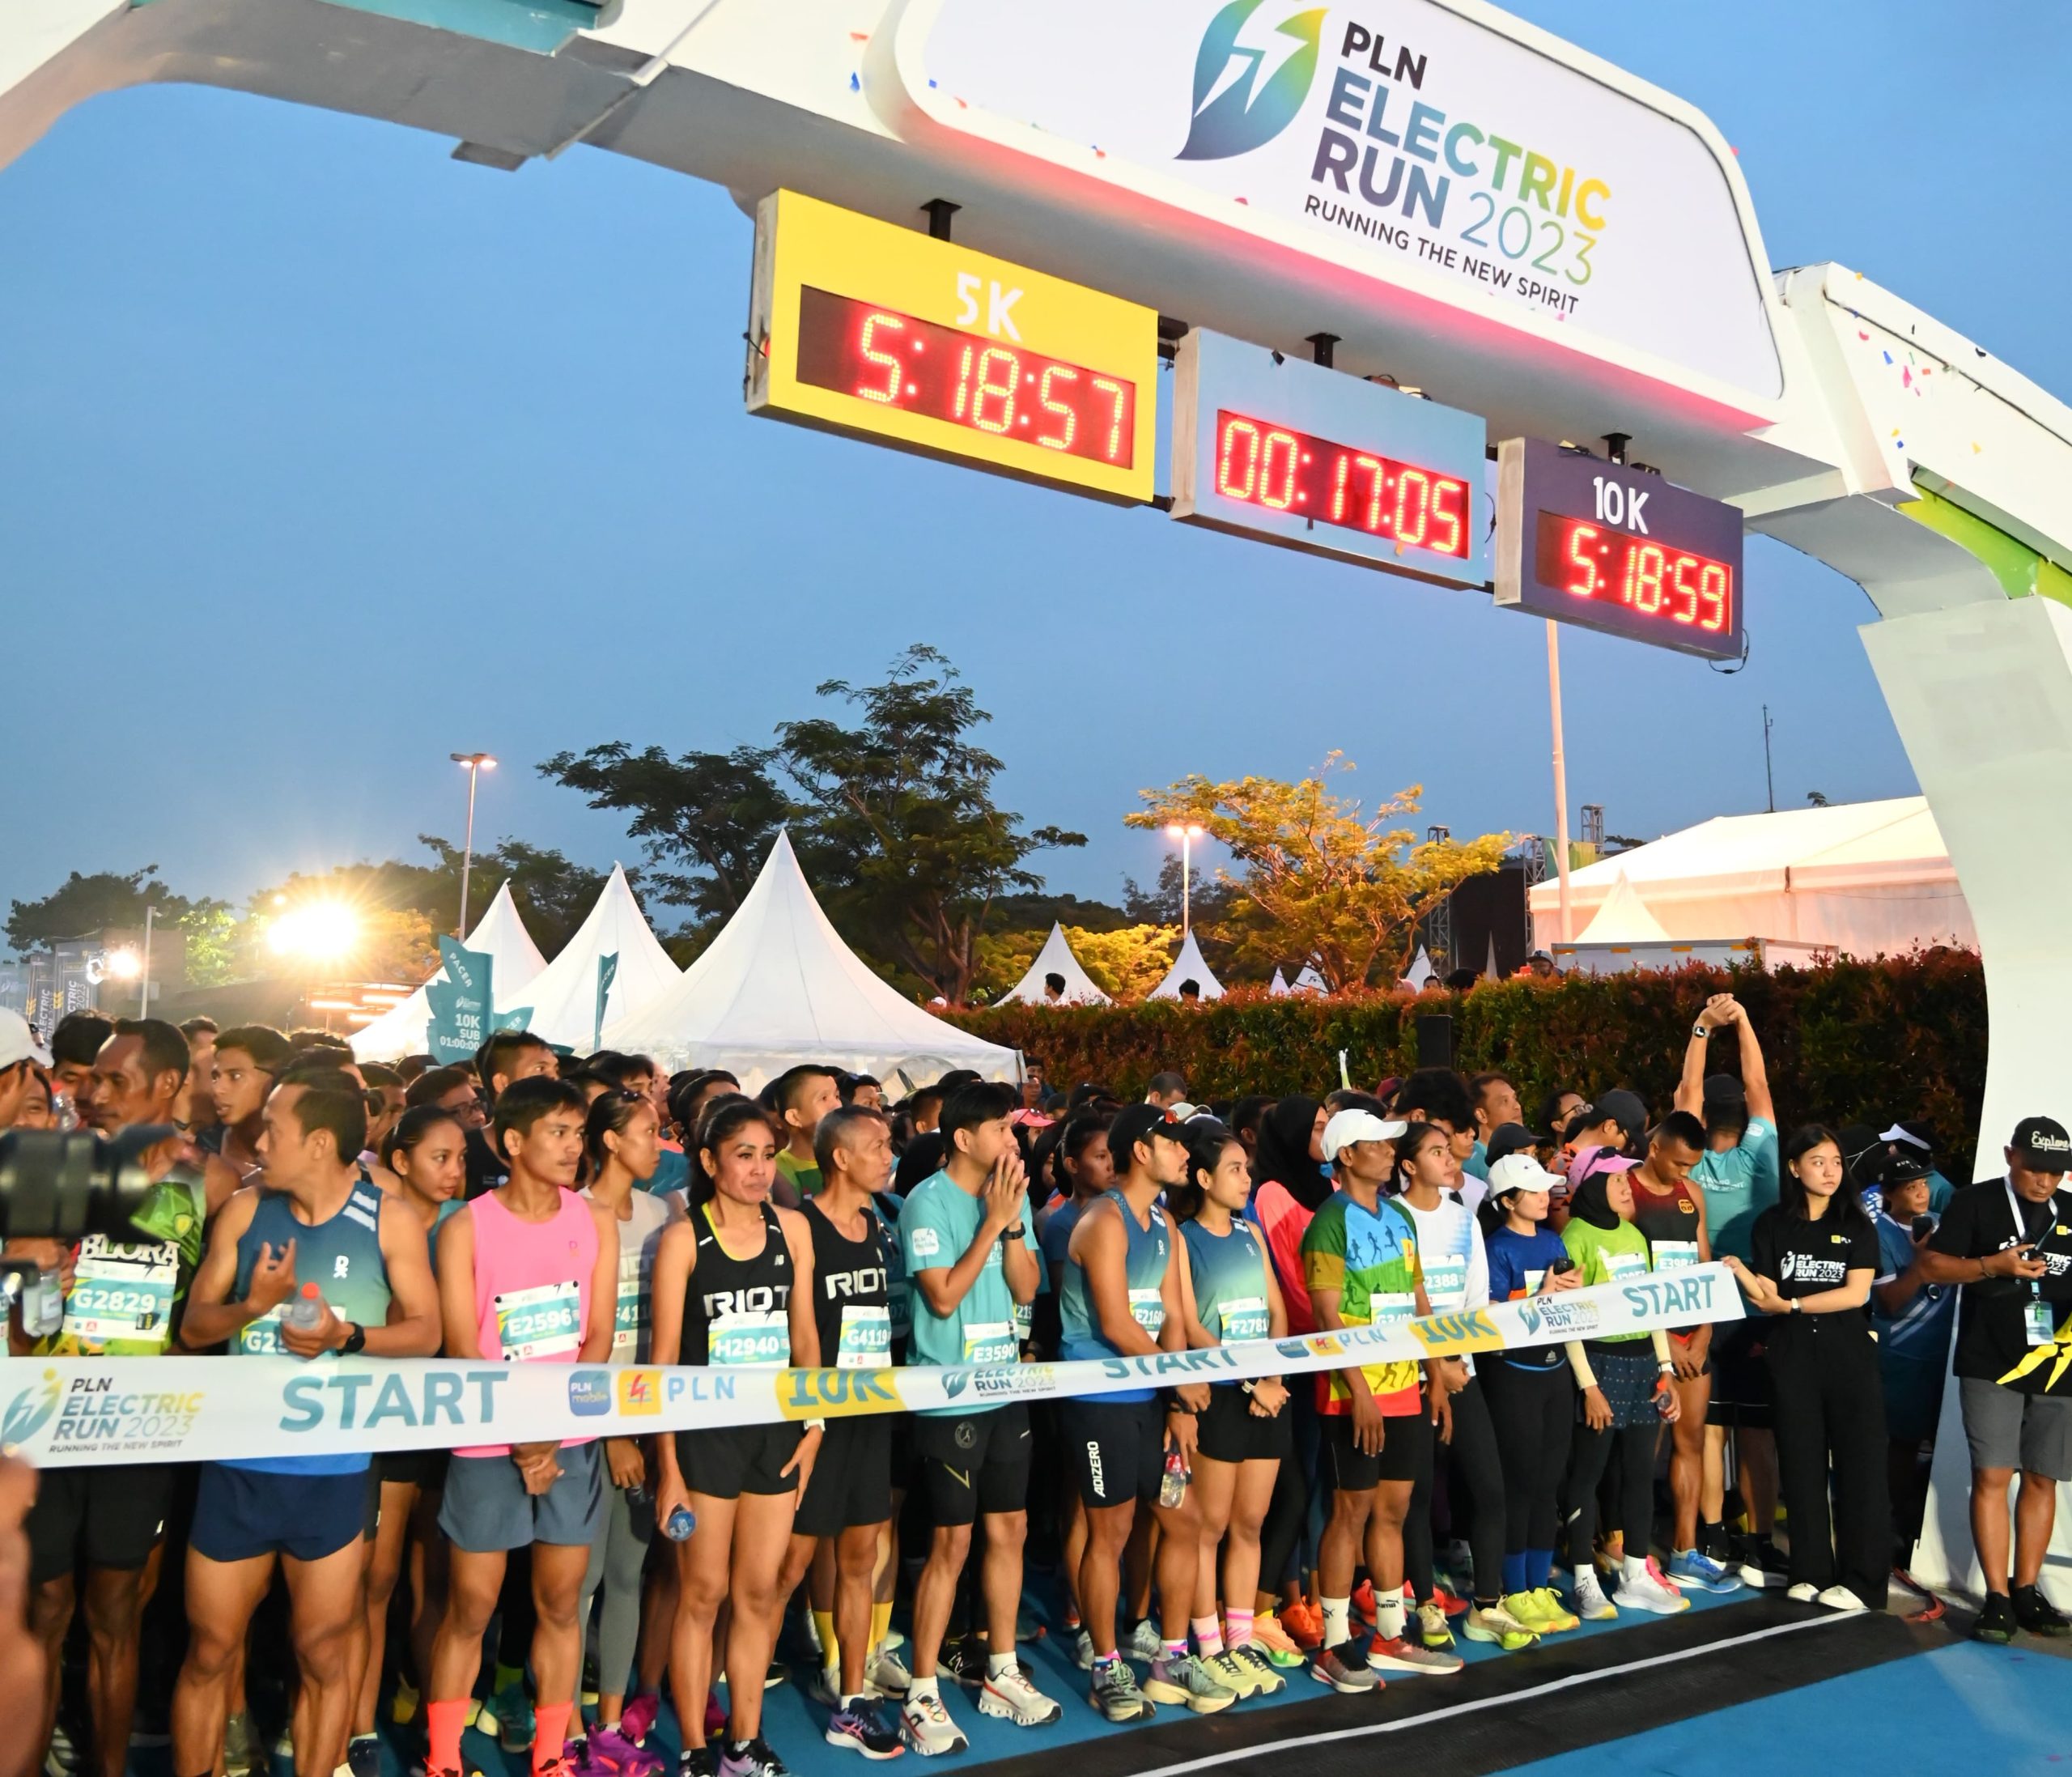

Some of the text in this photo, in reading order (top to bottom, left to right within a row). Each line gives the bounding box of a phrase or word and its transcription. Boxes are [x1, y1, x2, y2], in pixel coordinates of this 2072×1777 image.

[1341, 21, 1427, 91] PLN
[1326, 66, 1611, 231] ELECTRIC
[1311, 126, 1597, 285] RUN 2023
[1305, 194, 1578, 313] RUNNING THE NEW SPIRIT
[957, 272, 1023, 342] 5K
[1220, 420, 1459, 553] 00:17:05
[1593, 477, 1649, 534] 10K
[449, 952, 473, 988] PACER
[455, 1014, 481, 1029] 10K
[460, 1028, 480, 1040] SUB
[439, 1035, 480, 1051] 01:00:00
[1795, 1269, 1843, 1278] RUN 2023
[1796, 1260, 1845, 1270] ELECTRIC
[826, 1267, 887, 1299] RIOT
[1423, 1273, 1458, 1290] 2388
[74, 1288, 155, 1313] G2829
[703, 1286, 790, 1318] RIOT
[1537, 1296, 1552, 1305] PLN
[1539, 1300, 1597, 1316] ELECTRIC
[1622, 1274, 1715, 1318] START
[507, 1308, 571, 1337] E2596
[1136, 1308, 1162, 1324] E2160
[1230, 1317, 1268, 1334] F2781
[1415, 1309, 1497, 1344] 10K
[1546, 1314, 1571, 1327] RUN
[715, 1337, 779, 1358] H2940
[847, 1328, 888, 1344] G4119
[1338, 1328, 1387, 1347] PLN
[974, 1343, 1015, 1363] E3590
[1102, 1349, 1238, 1379] START
[71, 1377, 113, 1392] PLN
[571, 1382, 592, 1392] PLN
[668, 1375, 736, 1403] PLN
[788, 1371, 896, 1407] 10K
[974, 1376, 1055, 1391] RUN 2023
[62, 1392, 206, 1417] ELECTRIC
[279, 1371, 509, 1433] START
[53, 1415, 194, 1440] RUN 2023
[49, 1439, 183, 1453] RUNNING THE NEW SPIRIT
[1087, 1441, 1106, 1498] ADIZERO
